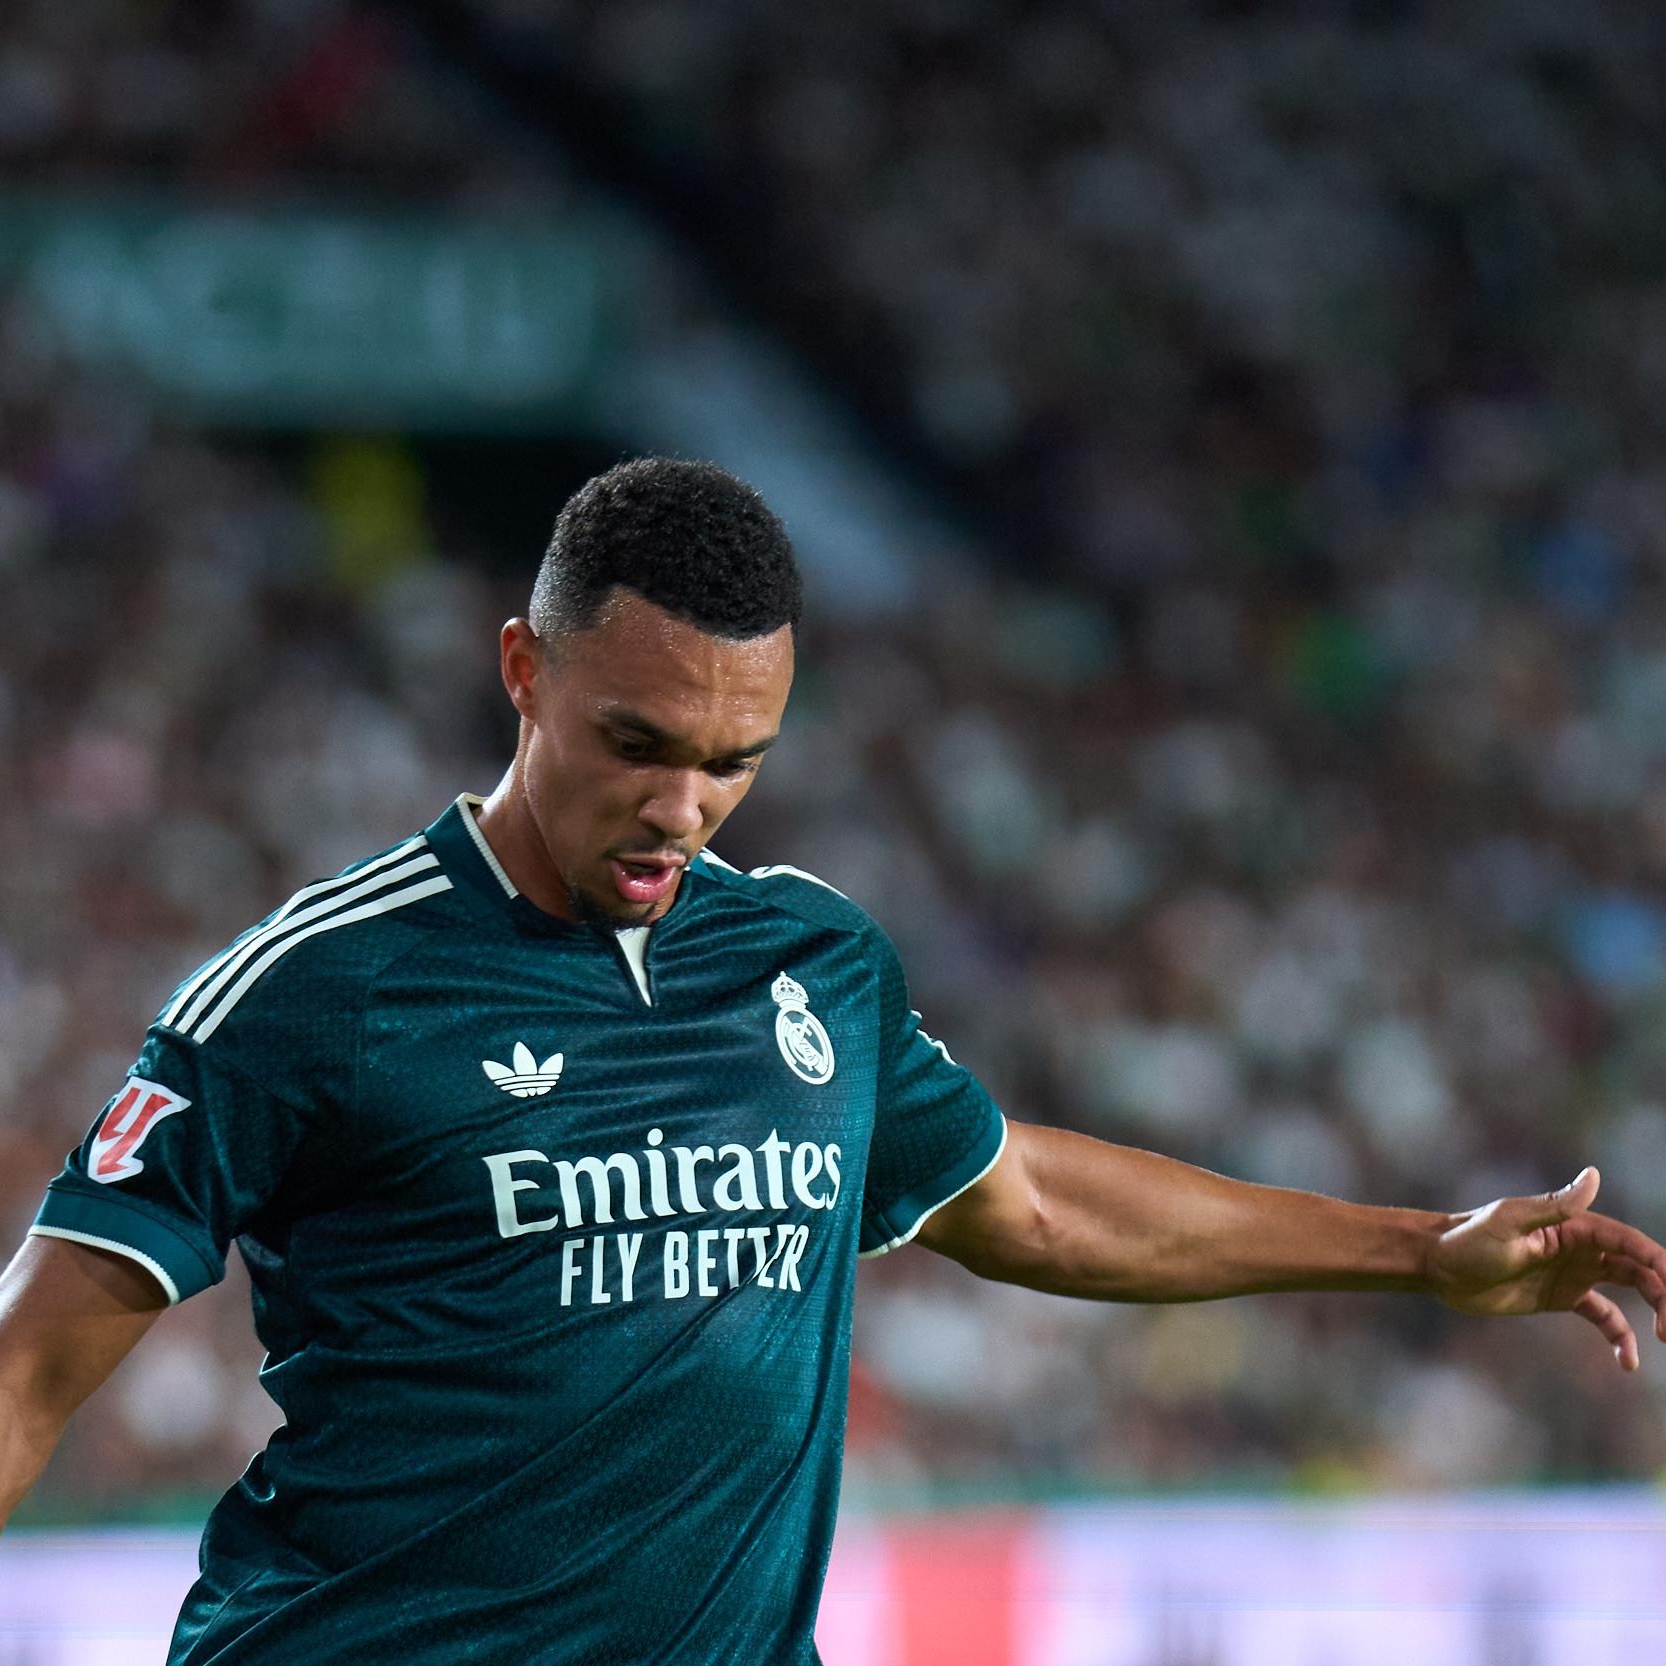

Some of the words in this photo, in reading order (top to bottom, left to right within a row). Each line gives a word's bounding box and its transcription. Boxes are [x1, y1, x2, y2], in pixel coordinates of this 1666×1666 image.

[482, 1128, 841, 1238] Emirates
[560, 1233, 643, 1306] FLY
[664, 1224, 809, 1299] BETTER
